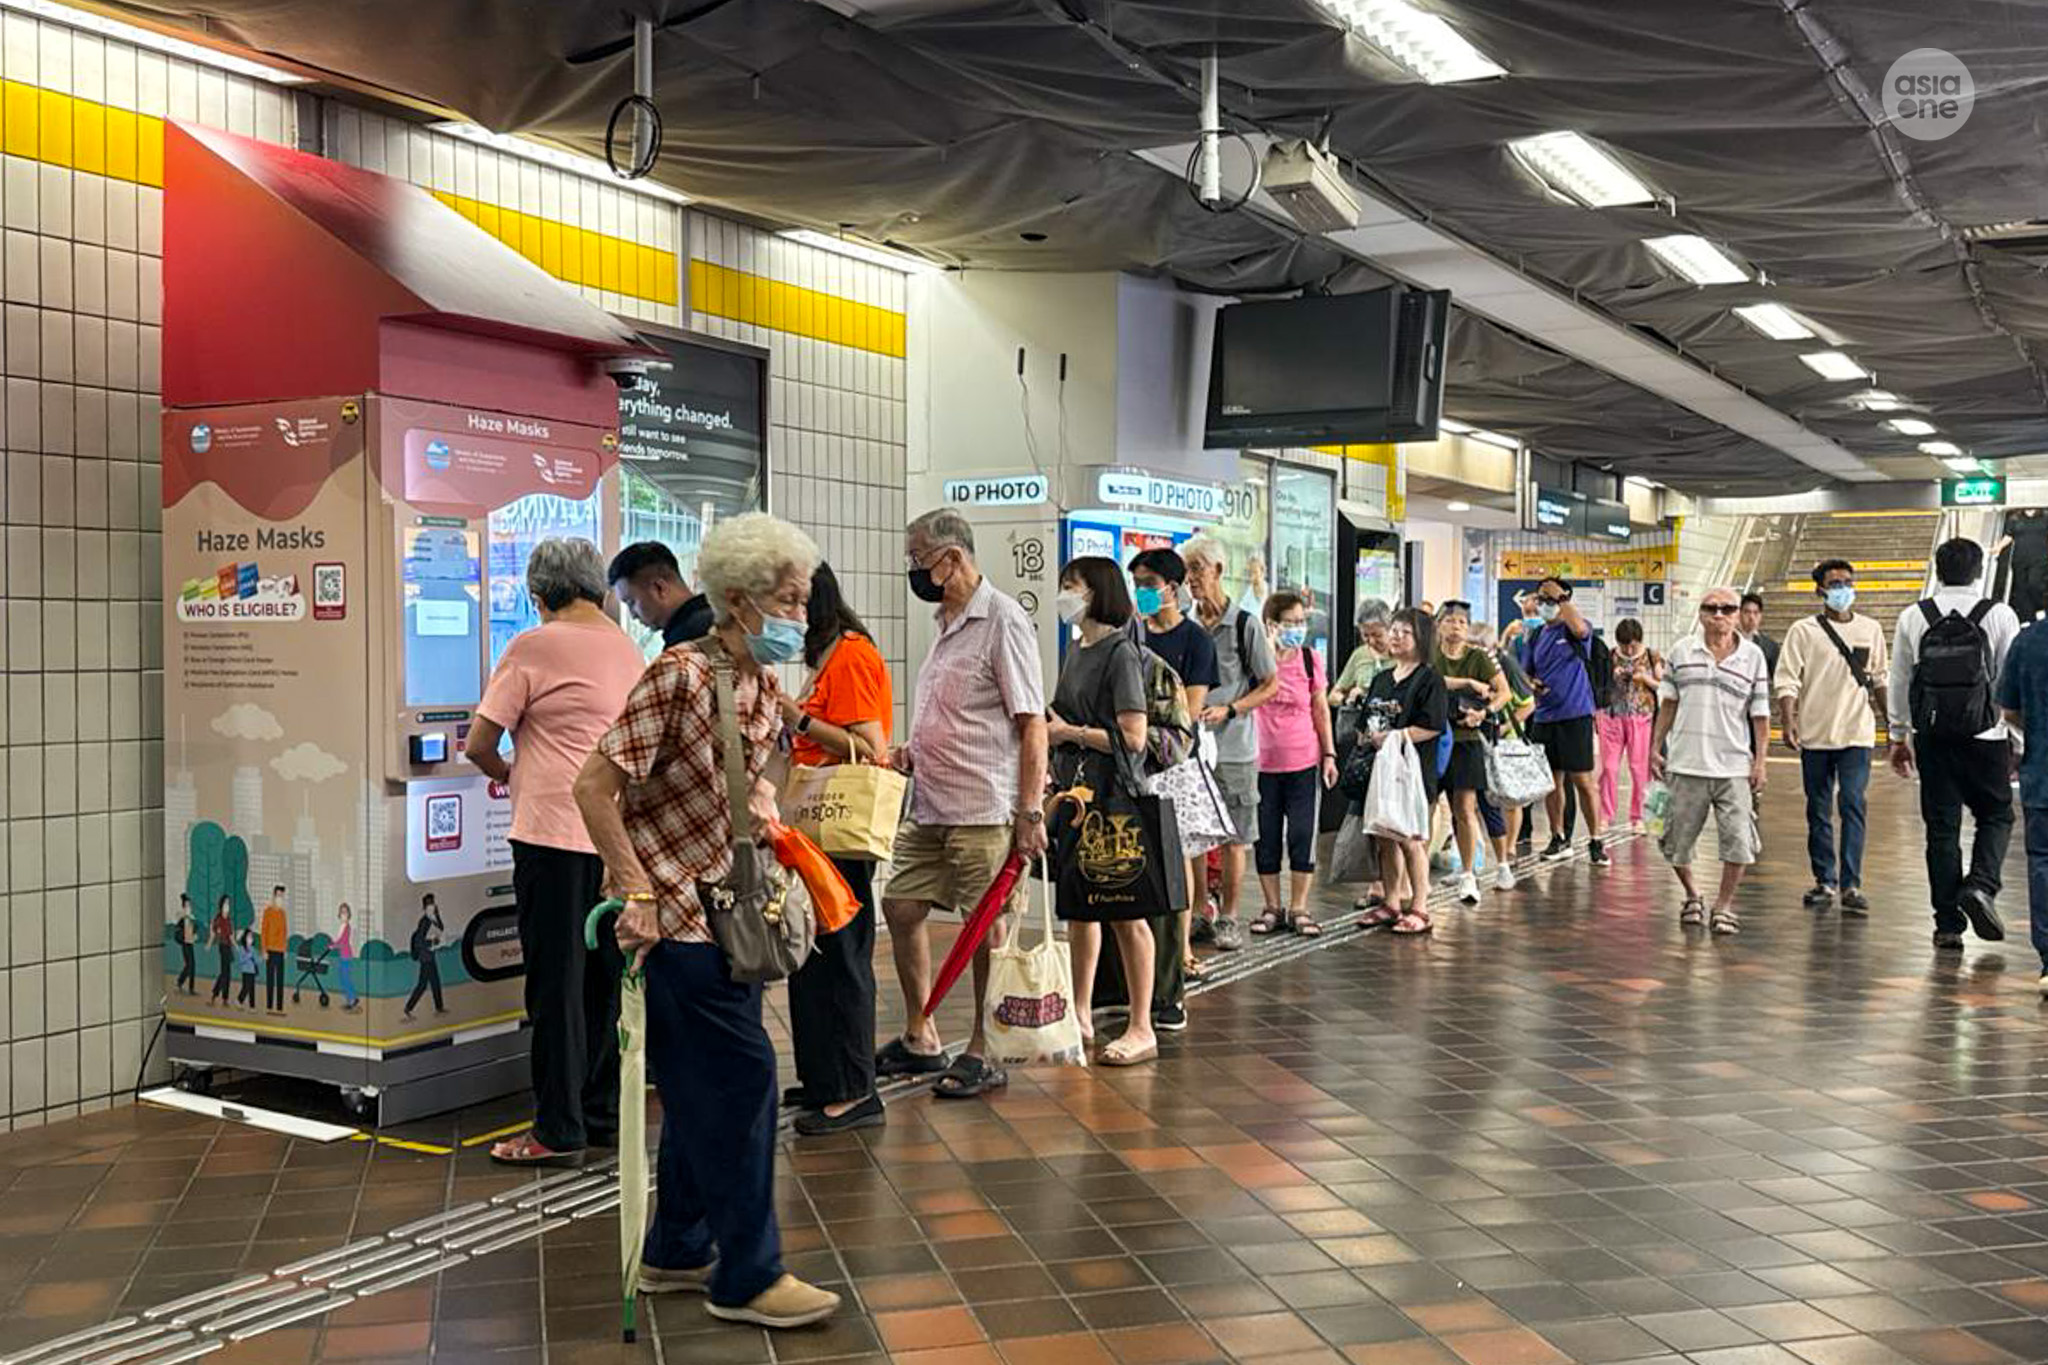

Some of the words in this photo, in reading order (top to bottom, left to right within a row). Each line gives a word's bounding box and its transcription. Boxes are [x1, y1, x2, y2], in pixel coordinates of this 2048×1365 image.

[468, 414, 504, 433] Haze
[506, 418, 551, 439] Masks
[674, 404, 733, 430] changed.
[638, 429, 660, 440] want
[660, 431, 670, 442] to
[952, 485, 970, 502] ID
[975, 482, 1040, 501] PHOTO
[1148, 481, 1163, 504] ID
[1167, 484, 1213, 512] PHOTO
[197, 529, 250, 552] Haze
[256, 525, 326, 551] Masks
[1012, 537, 1045, 578] 18
[1648, 585, 1660, 603] C
[184, 603, 216, 617] WHO
[218, 603, 230, 617] IS
[233, 601, 298, 617] ELIGIBLE?
